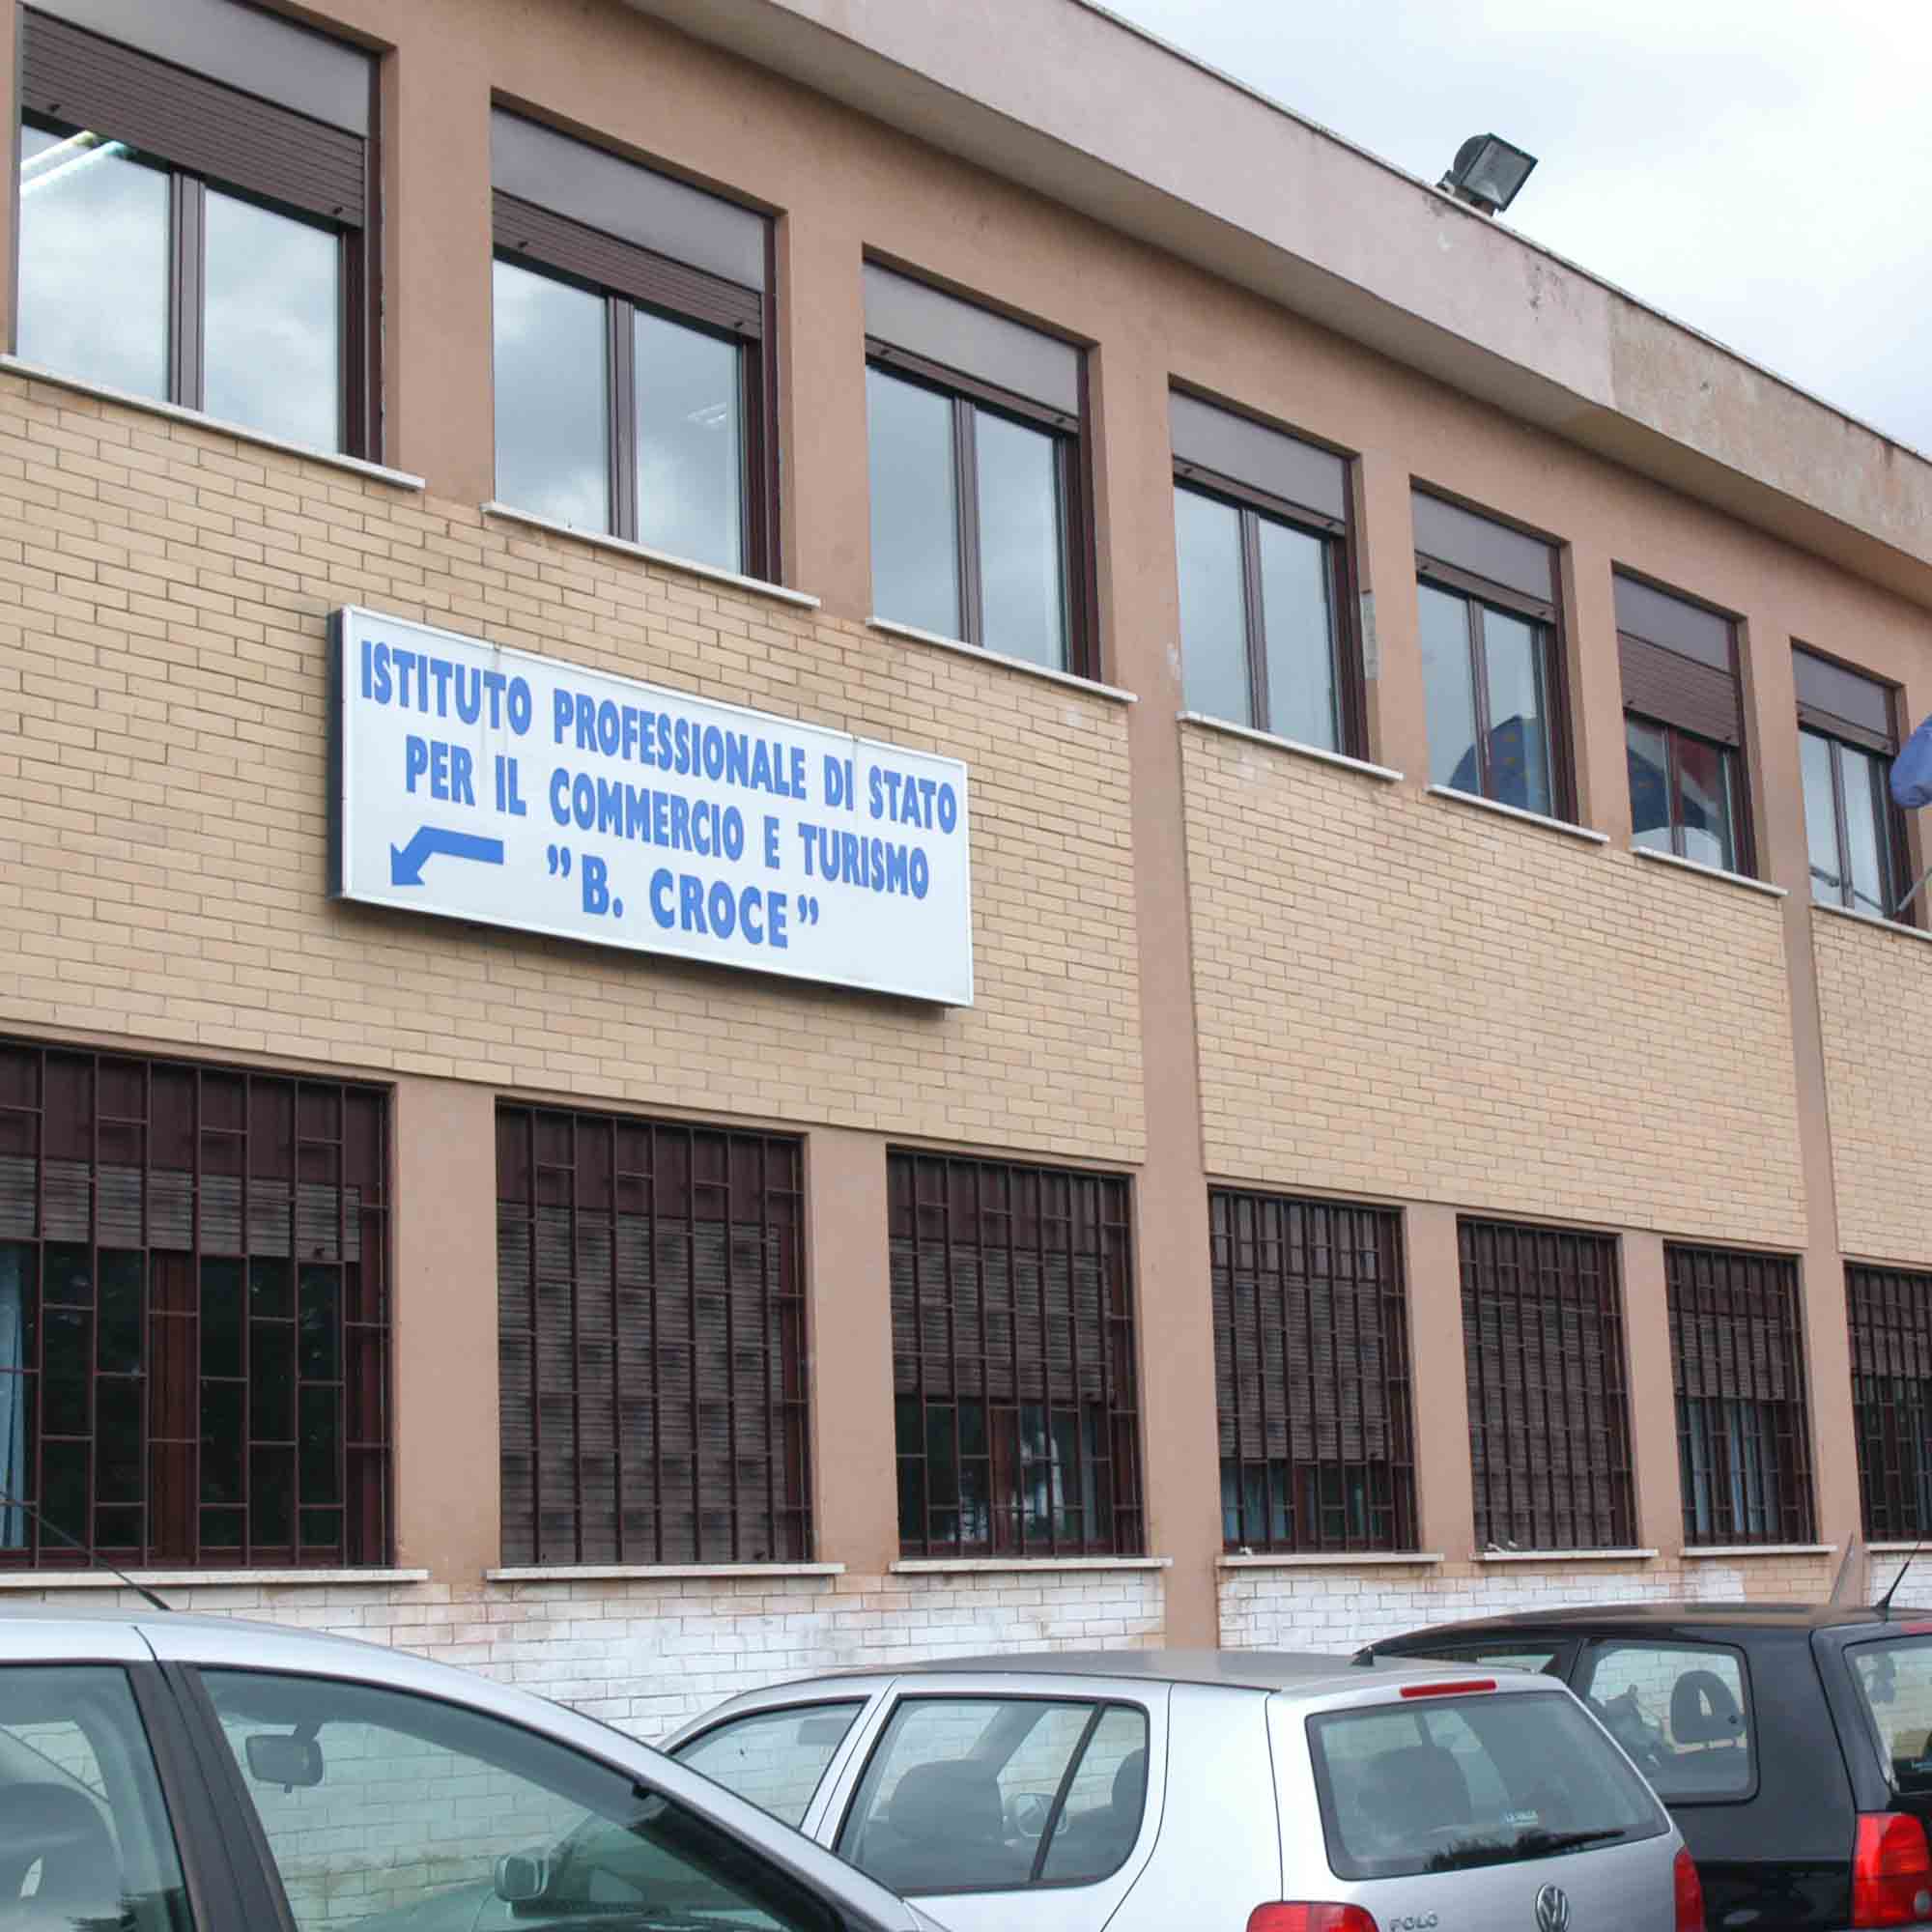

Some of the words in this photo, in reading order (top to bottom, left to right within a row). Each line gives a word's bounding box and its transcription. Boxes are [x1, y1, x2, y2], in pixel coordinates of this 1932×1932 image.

[359, 639, 533, 737] ISTITUTO
[552, 687, 809, 803] PROFESSIONALE
[822, 755, 856, 812] DI
[867, 764, 958, 836] STATO
[404, 732, 477, 806] PER
[494, 755, 527, 817] IL
[549, 766, 746, 864] COMMERCIO
[762, 813, 782, 871] E
[797, 820, 930, 898] TURISMO
[1389, 1913, 1439, 1932] POLO
